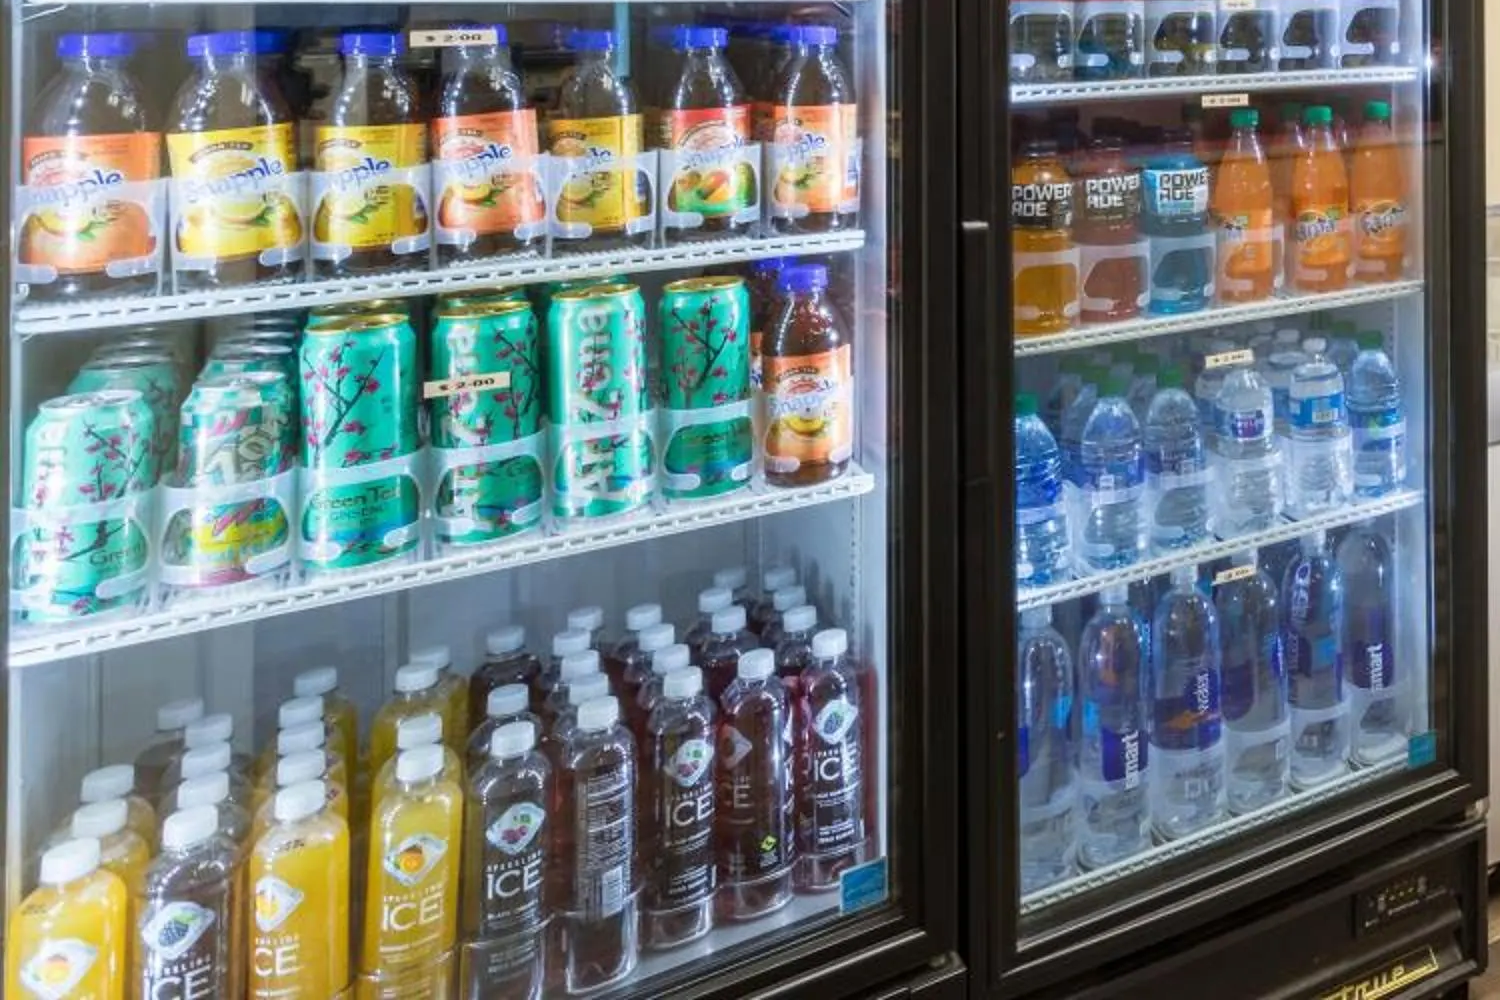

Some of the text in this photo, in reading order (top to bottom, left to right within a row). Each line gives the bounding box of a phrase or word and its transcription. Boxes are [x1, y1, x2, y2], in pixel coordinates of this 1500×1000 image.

[1012, 182, 1072, 201] POWER
[1087, 195, 1124, 209] ADE
[1011, 202, 1048, 217] ADE
[665, 790, 715, 829] ICE
[487, 857, 544, 900] ICE
[383, 888, 444, 932] ICE
[255, 943, 303, 977] CE
